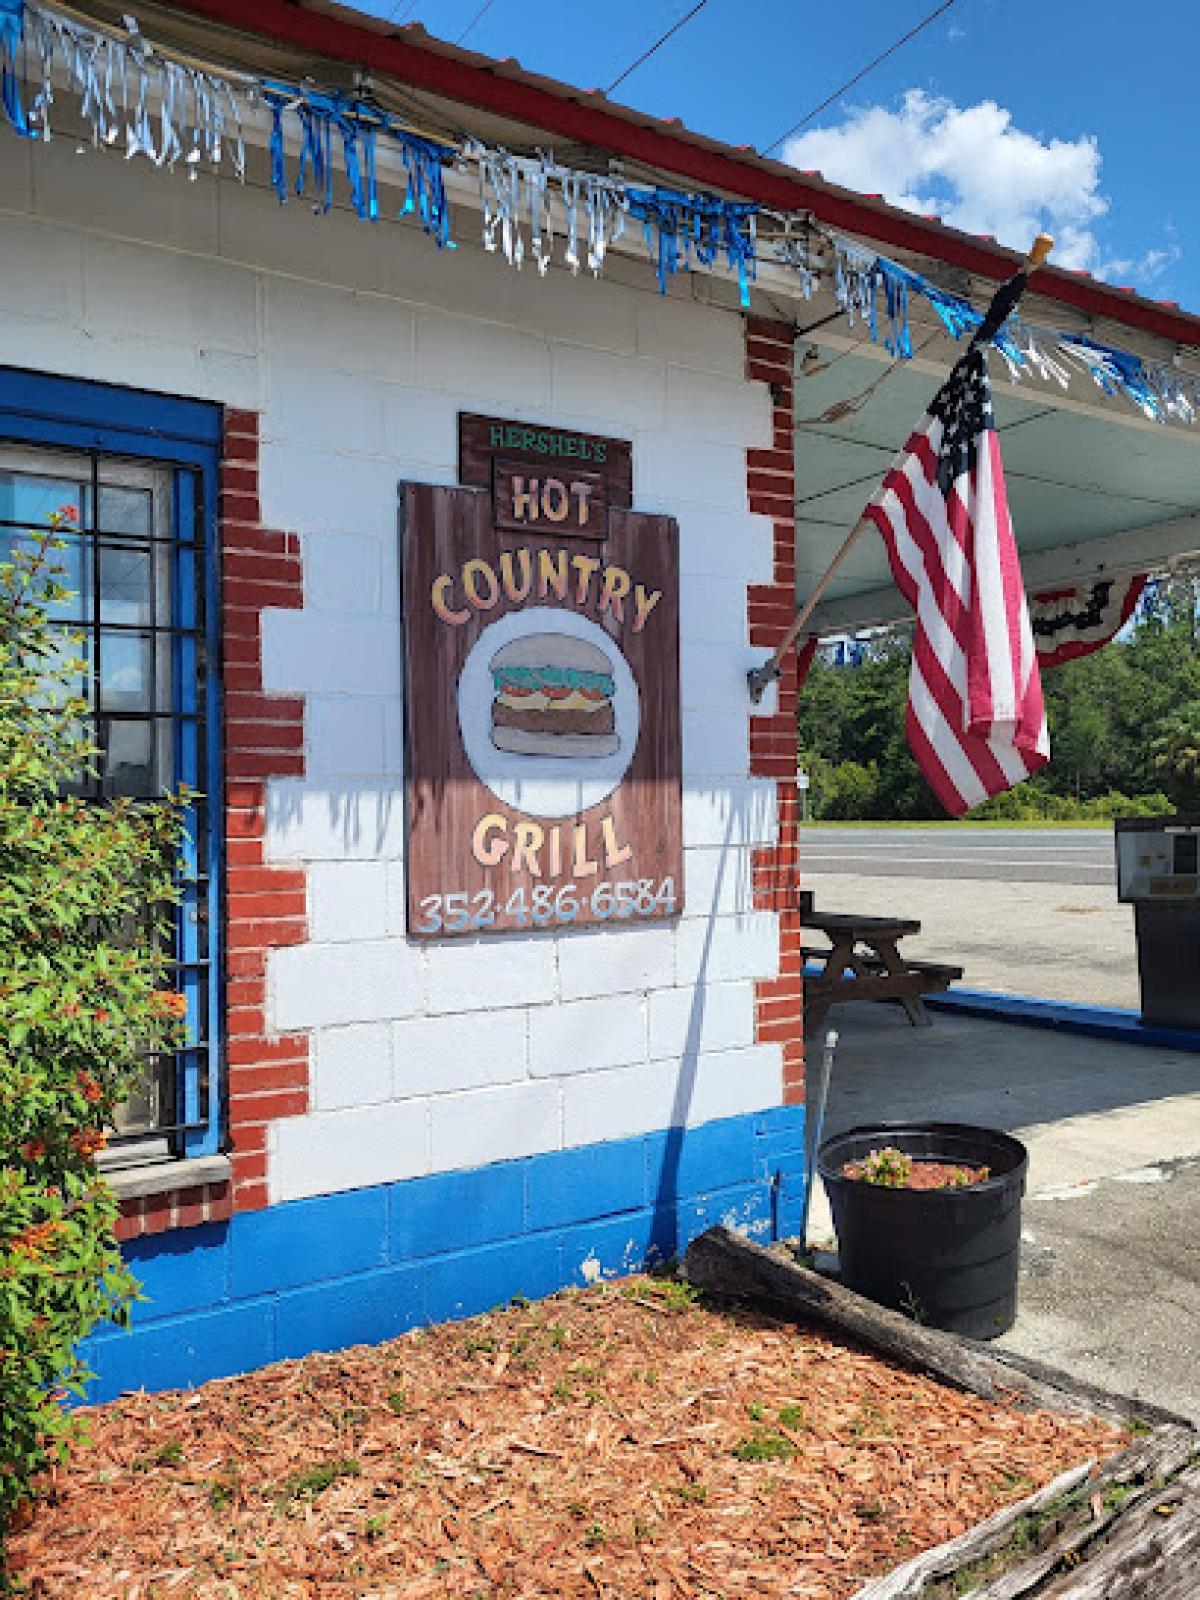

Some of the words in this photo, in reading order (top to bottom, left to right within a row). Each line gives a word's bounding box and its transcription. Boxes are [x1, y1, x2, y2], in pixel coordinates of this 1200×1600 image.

[511, 475, 592, 526] HOT
[431, 547, 662, 633] COUNTRY
[472, 813, 633, 878] GRILL
